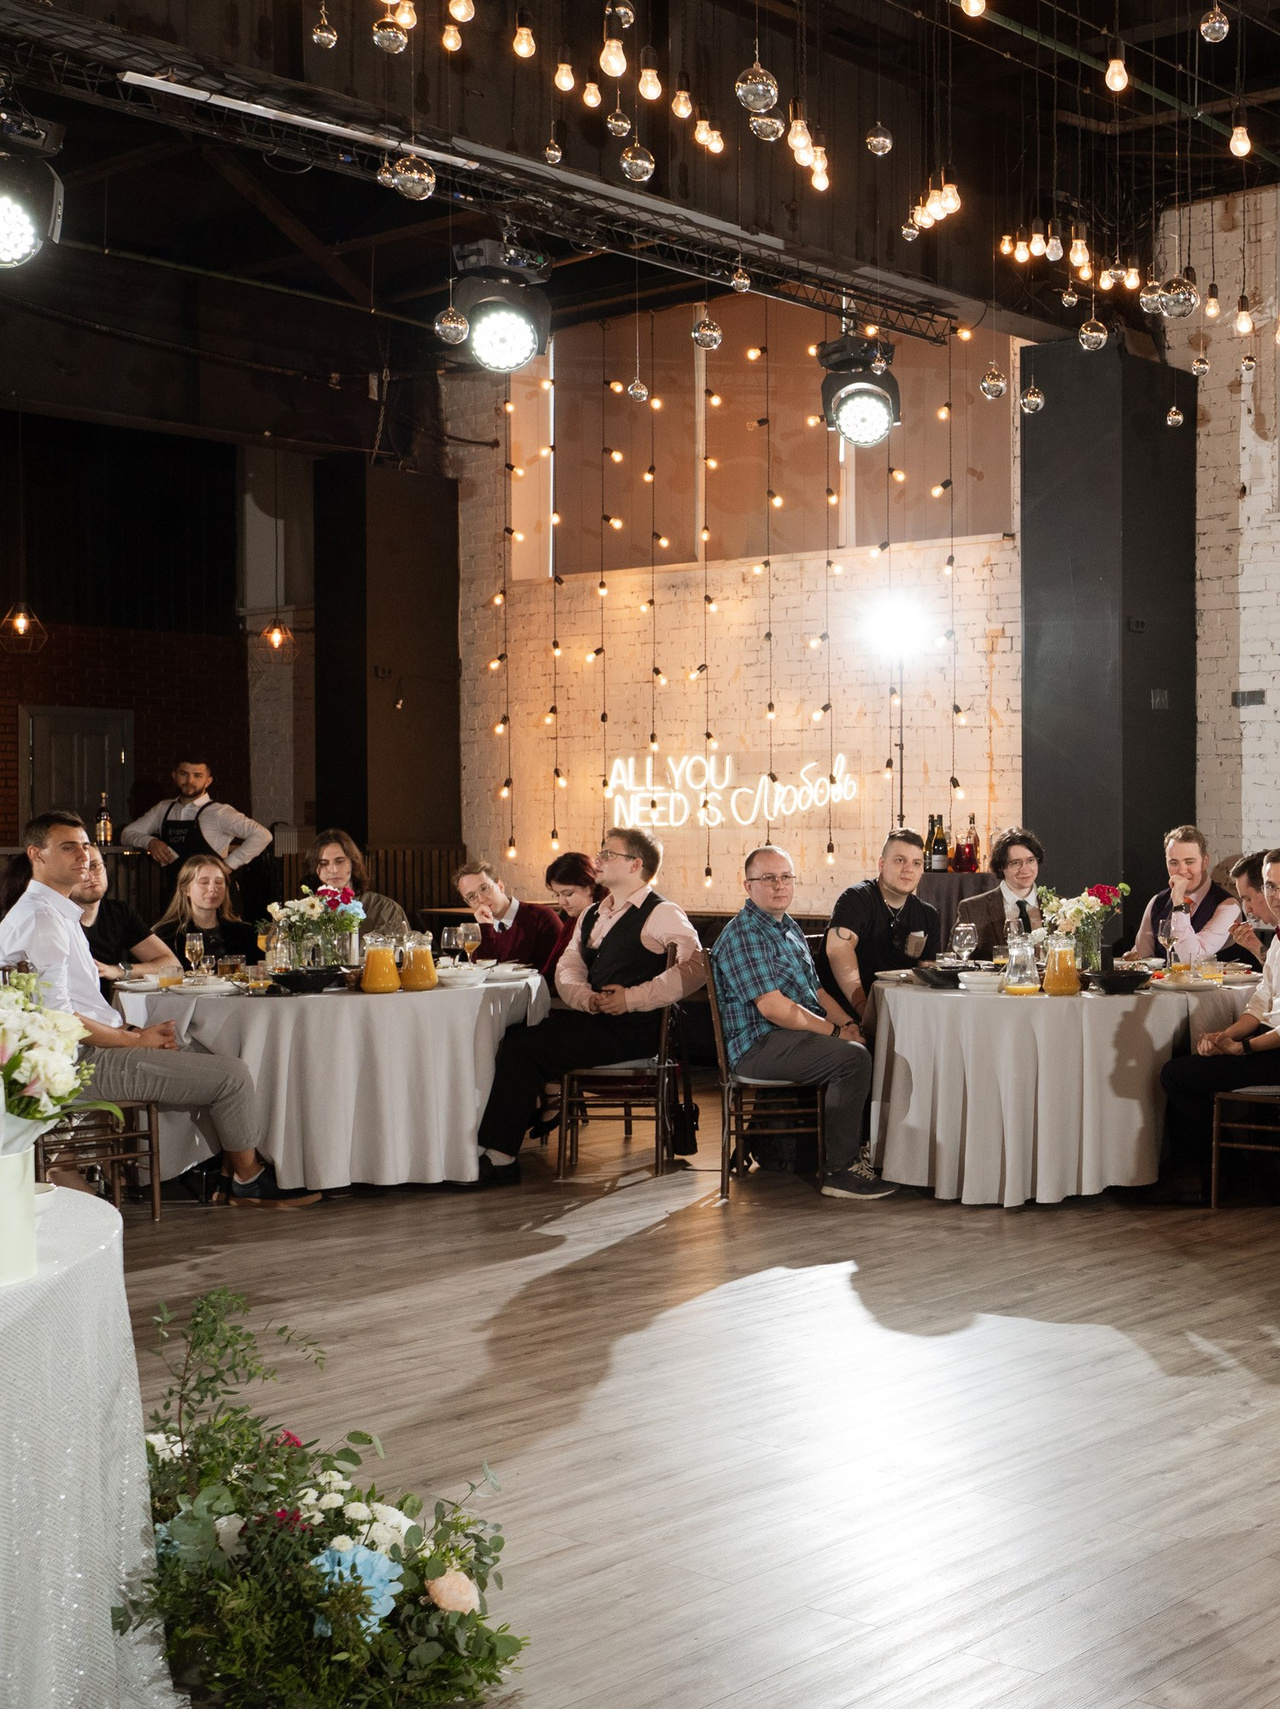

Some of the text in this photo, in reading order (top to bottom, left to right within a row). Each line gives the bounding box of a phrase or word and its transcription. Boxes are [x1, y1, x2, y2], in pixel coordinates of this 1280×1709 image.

[609, 755, 732, 791] ALL YOU
[613, 793, 689, 826] NEED
